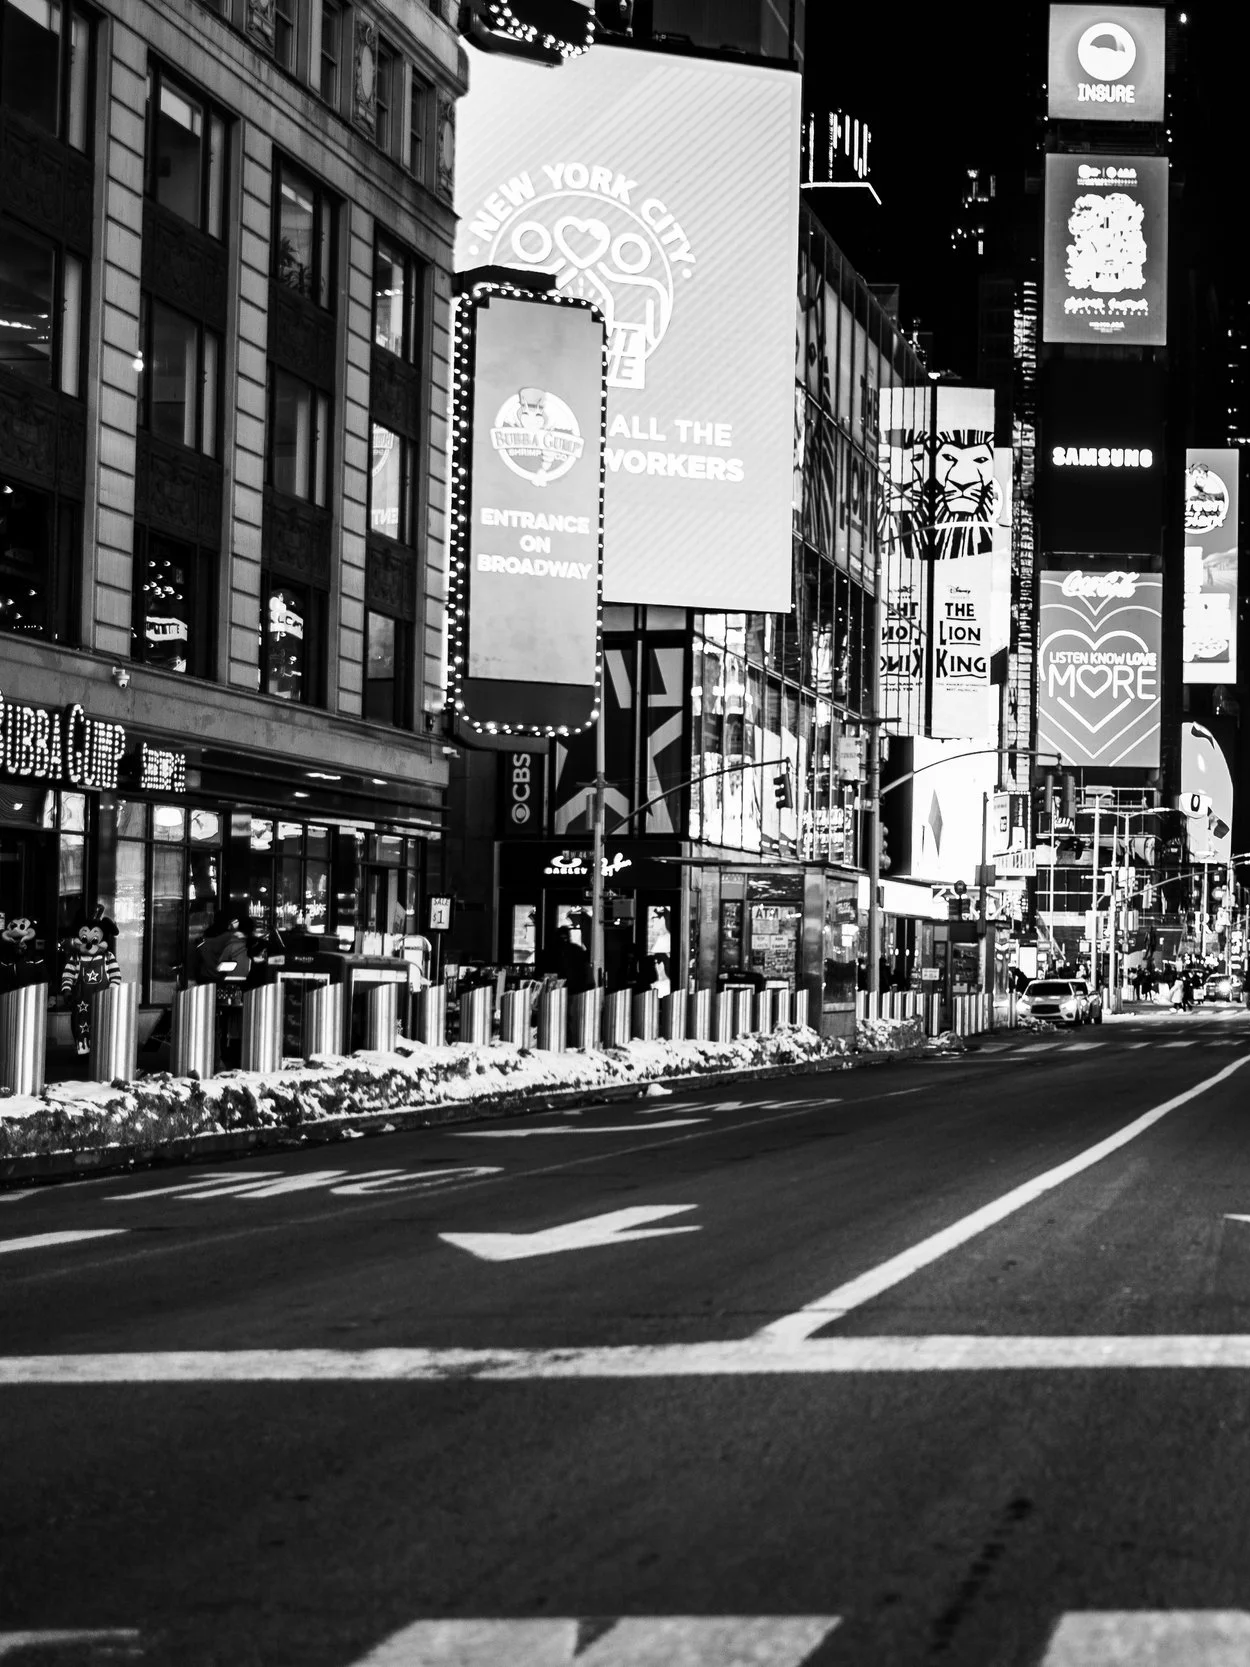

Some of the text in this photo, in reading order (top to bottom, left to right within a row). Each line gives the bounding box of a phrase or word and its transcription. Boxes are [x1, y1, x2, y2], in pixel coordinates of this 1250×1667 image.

[467, 162, 697, 264] NEW YORK CITY
[494, 430, 539, 448] BUBBA
[608, 414, 733, 447] ALL THE
[604, 448, 745, 482] WORKERS
[1052, 446, 1153, 468] SAMSUNG
[1185, 498, 1225, 512] reen
[480, 507, 590, 535] ENTRANCE
[519, 534, 551, 554] ON
[476, 553, 593, 580] BROADWAY
[945, 602, 974, 617] THE
[939, 620, 981, 646] LION
[935, 648, 987, 678] KING
[1049, 651, 1157, 665] LISTEN KNOW LOVE
[0, 694, 62, 780] UBBA
[512, 753, 531, 802] CBS
[755, 907, 779, 920] ATM
